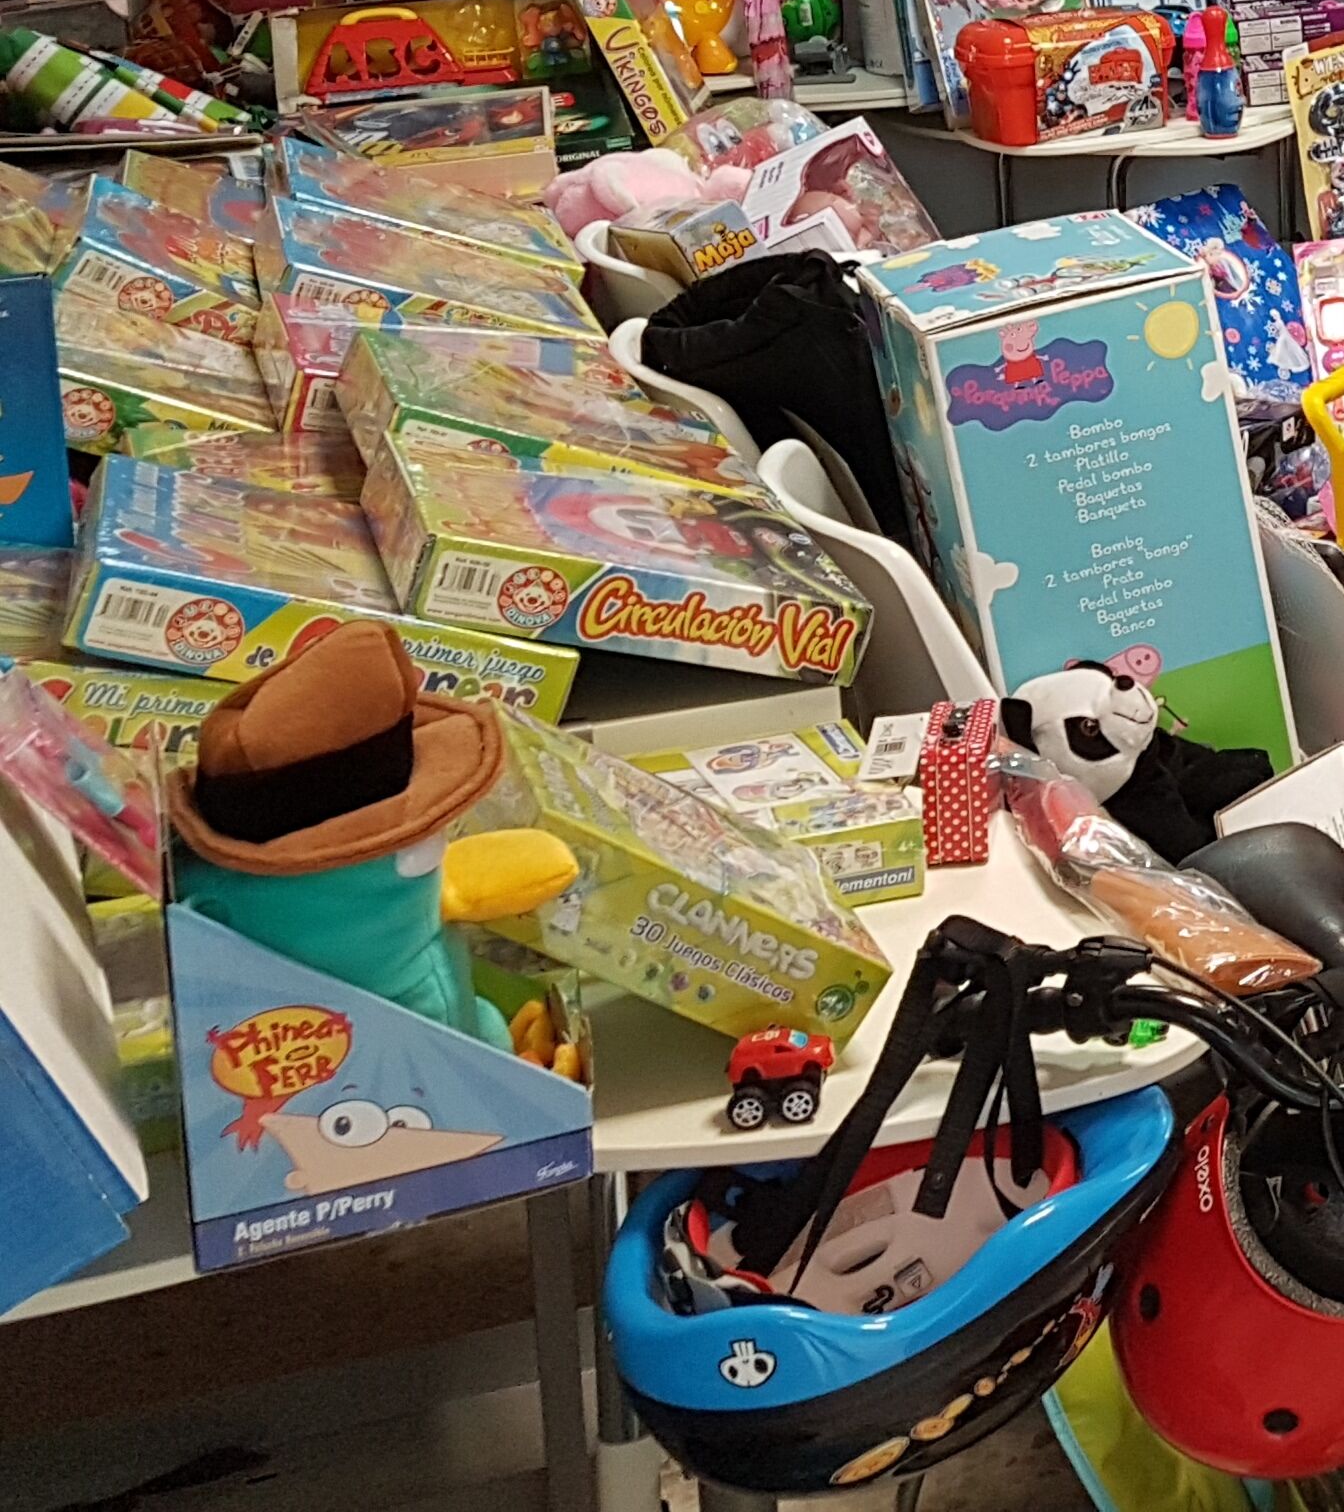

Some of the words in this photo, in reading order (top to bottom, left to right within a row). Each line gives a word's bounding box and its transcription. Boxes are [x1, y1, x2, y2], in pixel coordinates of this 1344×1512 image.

[694, 228, 756, 274] Maja
[1050, 358, 1108, 392] Peppa
[1026, 453, 1038, 468] 2
[1044, 437, 1117, 464] tambores
[1120, 422, 1172, 443] bongos
[1069, 418, 1123, 439] Bombo
[1058, 473, 1098, 494] Pedal
[1102, 461, 1153, 483] bombo
[1076, 450, 1129, 473] Platillo
[1075, 481, 1143, 506] Baquetas
[1077, 497, 1147, 523] Banqueta
[1091, 536, 1144, 558] Bombo
[1045, 574, 1057, 588] 2
[1063, 555, 1134, 583] tambores
[1103, 569, 1144, 589] Prato
[1079, 591, 1119, 613] Pedal
[1122, 578, 1173, 600] bombo
[1097, 597, 1164, 624] Baquetas
[505, 607, 552, 626] DINOVA
[581, 580, 776, 655] Circulación
[777, 603, 854, 672] Vial
[1110, 617, 1156, 638] Banco
[171, 639, 226, 664] DINOVA
[477, 648, 546, 683] juego
[85, 681, 125, 708] Mi
[130, 692, 215, 719] prime
[834, 868, 914, 895] lementoni
[647, 883, 820, 980] CLANNERS
[629, 915, 666, 943] 30
[665, 934, 721, 972] Juegos
[724, 960, 795, 1003] Clásicos
[1196, 1145, 1213, 1213] oxelo
[233, 1207, 313, 1243] Agente
[314, 1188, 397, 1222] P/Perry
